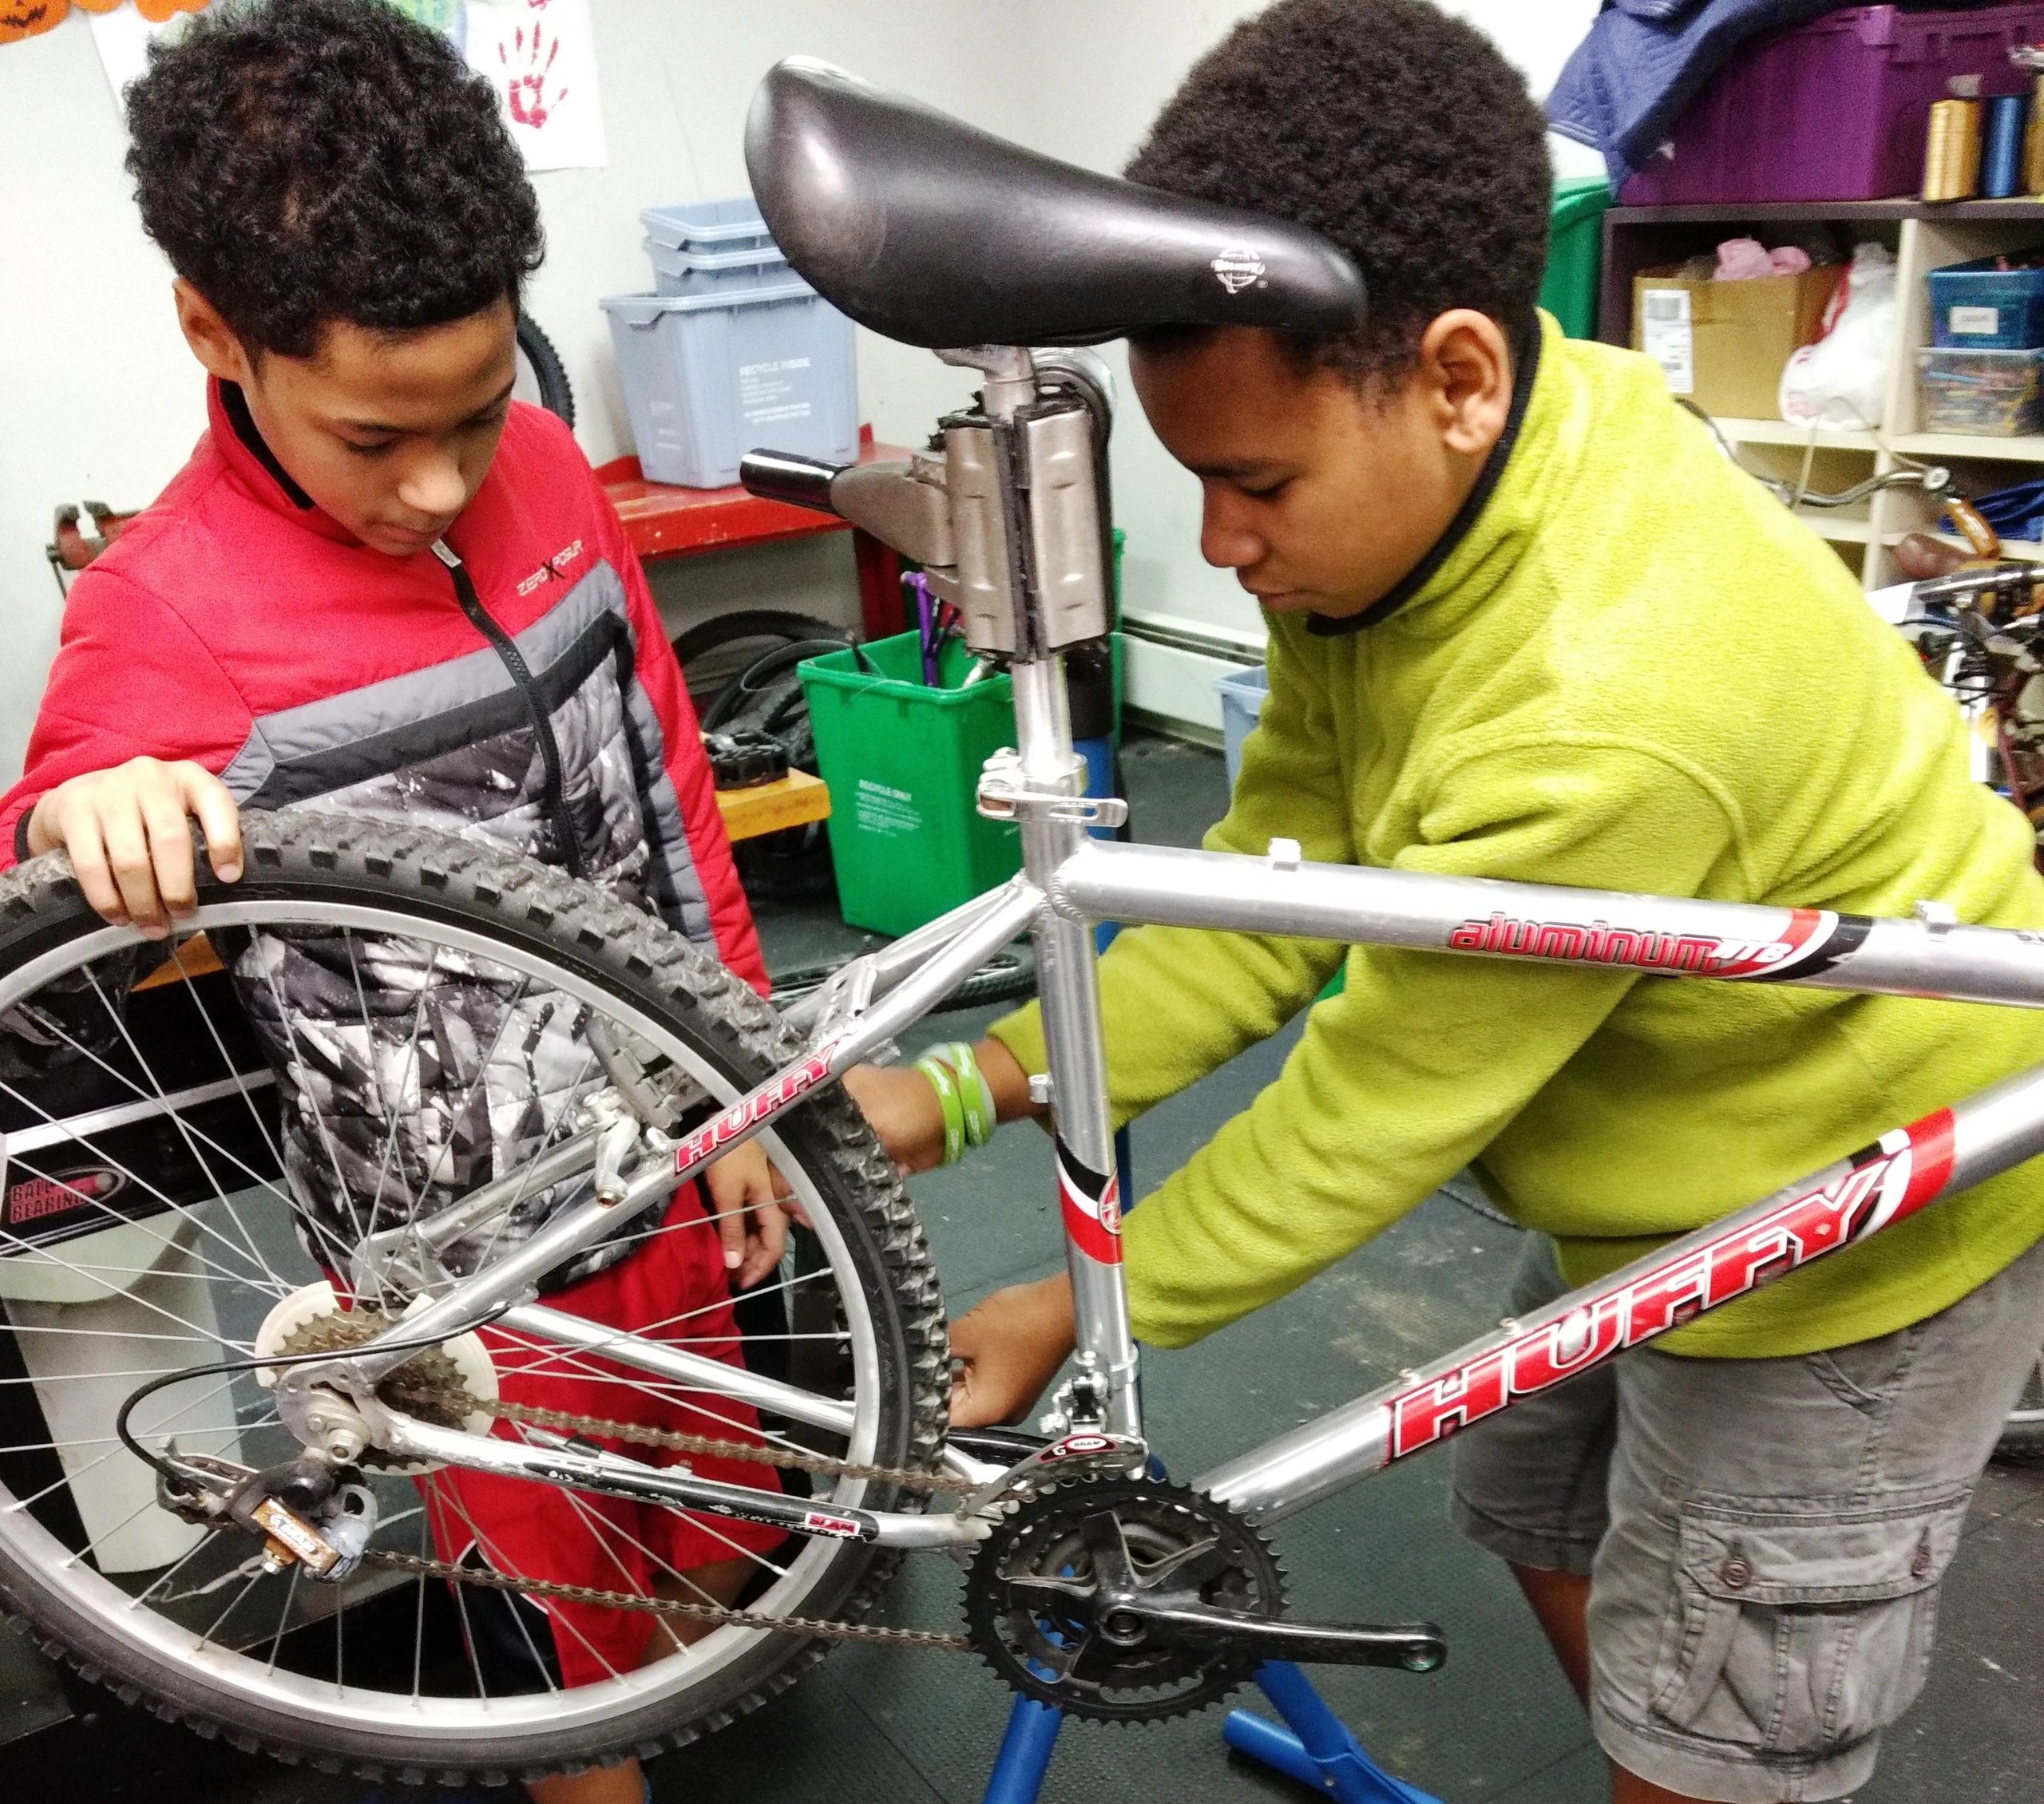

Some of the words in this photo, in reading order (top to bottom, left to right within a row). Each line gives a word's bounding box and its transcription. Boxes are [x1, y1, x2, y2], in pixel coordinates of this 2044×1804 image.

[1448, 911, 1723, 972] aluminum
[675, 1041, 838, 1174] HUFFY
[1393, 1160, 1891, 1458] HUFFY
